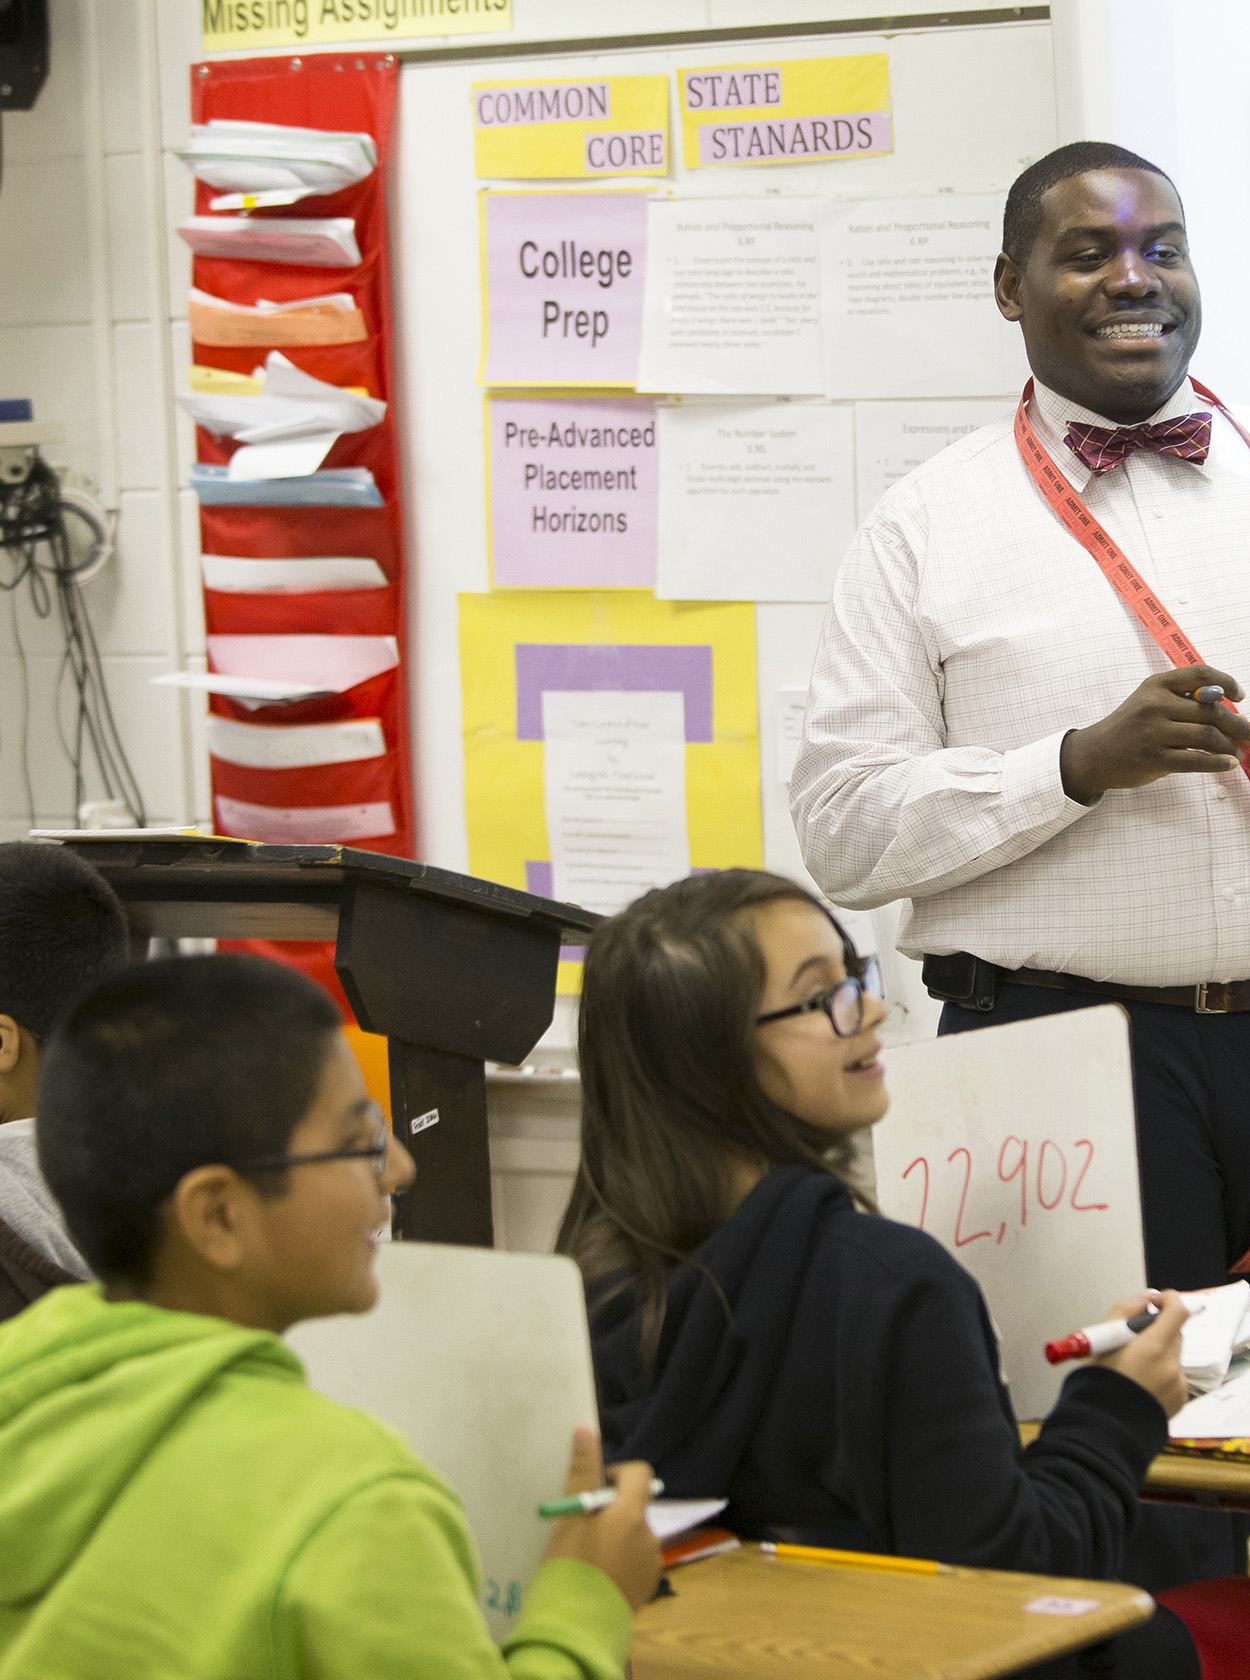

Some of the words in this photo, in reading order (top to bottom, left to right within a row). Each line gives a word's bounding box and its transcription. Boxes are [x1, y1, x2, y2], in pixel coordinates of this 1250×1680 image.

[203, 0, 308, 37] Missing
[477, 85, 608, 125] COMMON
[686, 72, 781, 109] STATE
[587, 133, 664, 169] CORE
[711, 117, 874, 160] STANARDS
[677, 224, 703, 232] Ratios
[705, 224, 720, 232] and
[722, 222, 771, 232] Proportional
[774, 222, 815, 232] Reasoning
[849, 224, 874, 233] Ratios
[875, 223, 892, 232] and
[894, 221, 945, 233] Proportional
[948, 220, 991, 231] Reasoning
[520, 240, 633, 289] College
[543, 299, 609, 348] Prep
[505, 421, 655, 448] Pre-Advanced
[718, 429, 732, 439] The
[734, 429, 767, 439] Number
[770, 429, 798, 440] System
[903, 424, 950, 434] Expressions
[952, 425, 968, 434] and
[1026, 437, 1037, 454] ADMIT
[1033, 451, 1044, 464] ONE
[524, 463, 637, 490] Placement
[1043, 465, 1056, 483] ADMIT
[1054, 480, 1065, 494] ONE
[532, 505, 628, 533] Horizons
[1065, 497, 1081, 515] ADMIT
[1078, 511, 1092, 528] ONE
[1092, 530, 1110, 550] ADMIT
[1106, 547, 1118, 561] ONE
[1118, 563, 1134, 583] ADMIT
[1130, 579, 1143, 593] ONE
[1143, 597, 1161, 616] ADMIT
[1158, 614, 1171, 629] ONE
[1170, 632, 1189, 652] ADMIT
[1184, 650, 1198, 665] ONE
